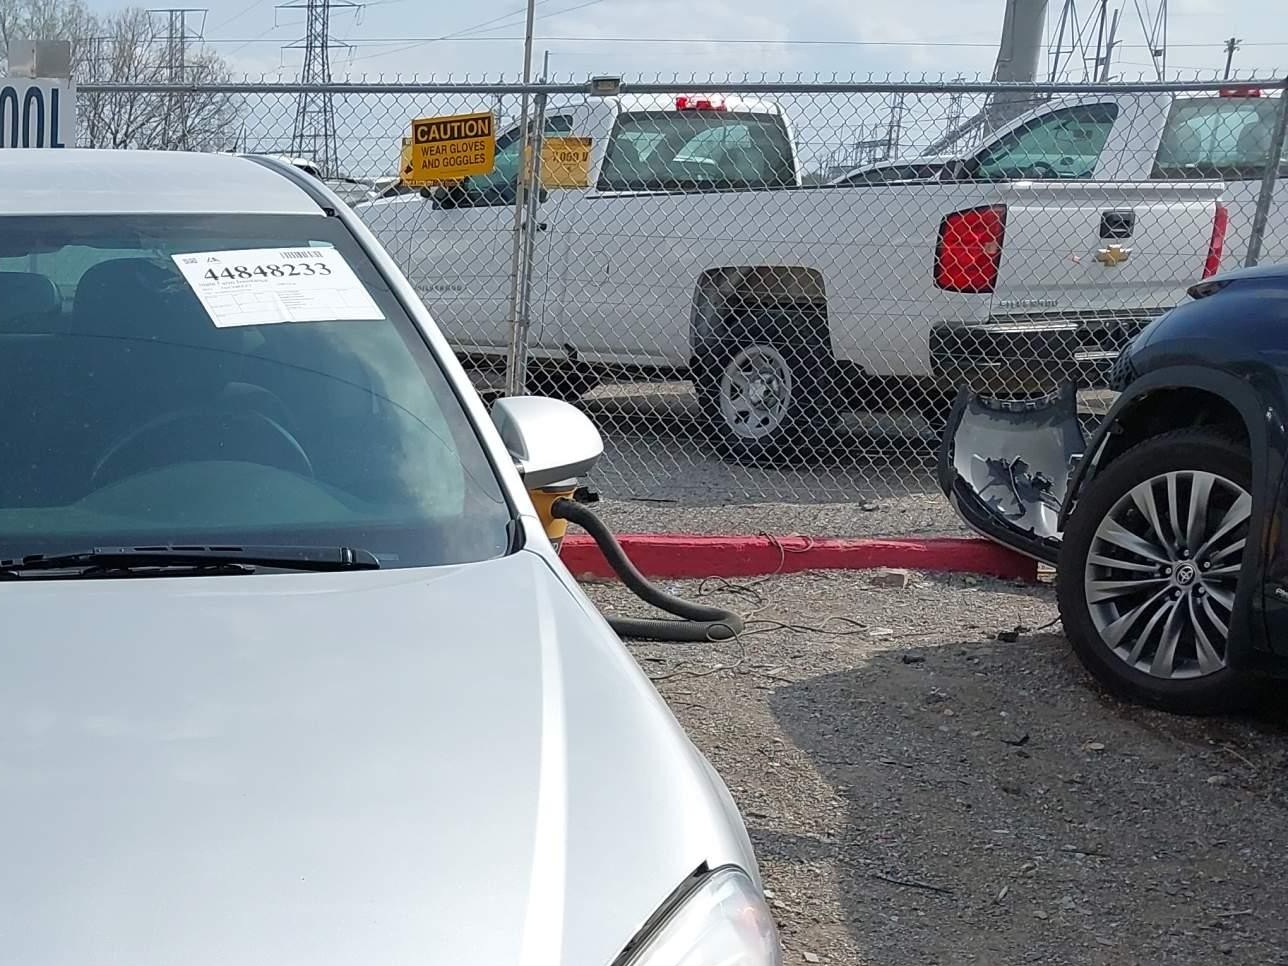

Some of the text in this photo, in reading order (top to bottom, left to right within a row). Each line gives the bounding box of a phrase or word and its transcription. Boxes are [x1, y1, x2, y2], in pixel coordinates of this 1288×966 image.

[417, 119, 489, 142] CAUTION
[421, 141, 486, 157] WEAR GLOVES
[422, 154, 486, 170] AND GOGGLES
[204, 262, 332, 281] 44848233
